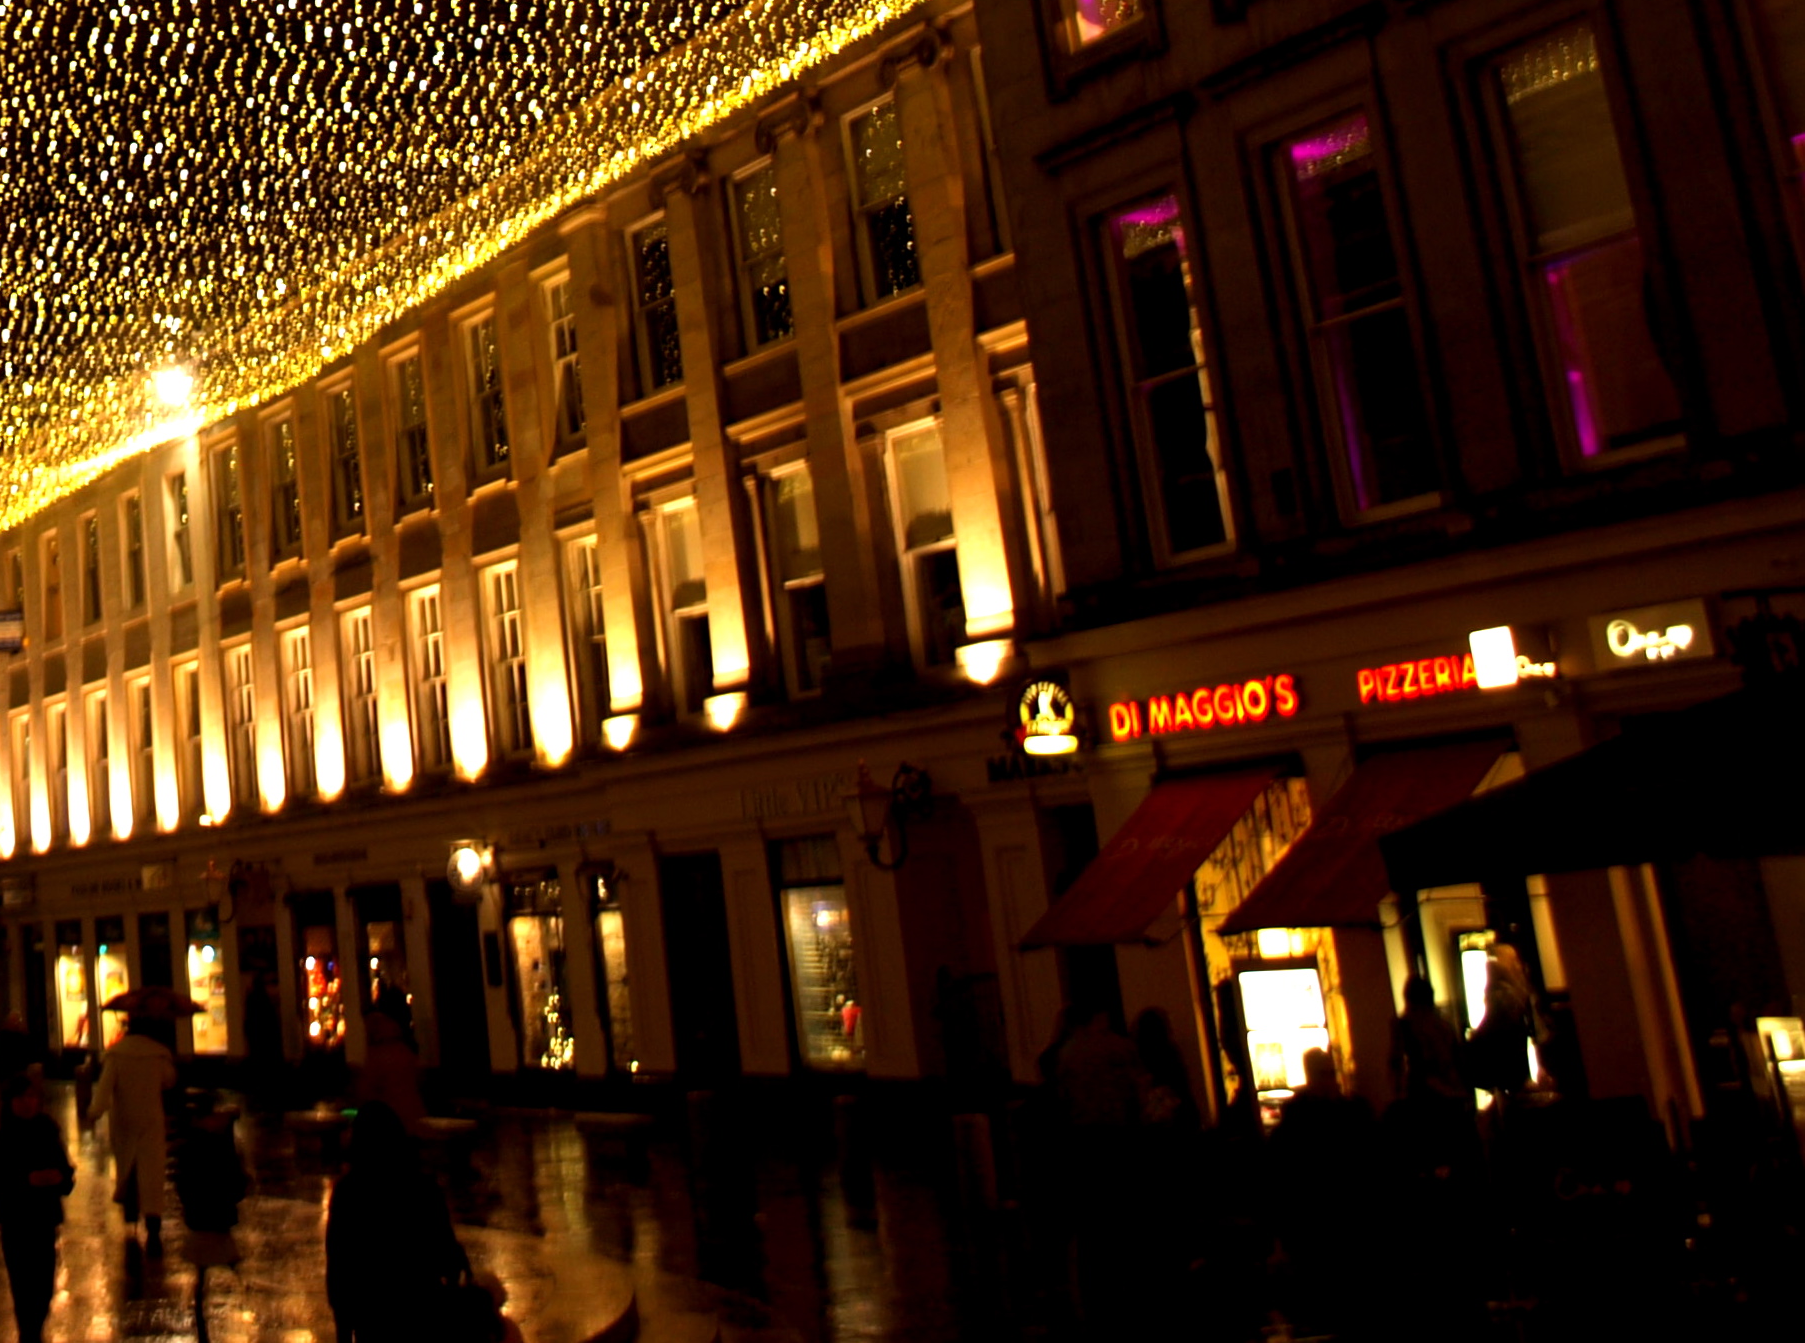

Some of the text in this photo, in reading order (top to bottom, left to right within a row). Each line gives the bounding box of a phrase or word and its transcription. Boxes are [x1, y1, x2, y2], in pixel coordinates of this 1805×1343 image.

[1109, 674, 1299, 742] DI MAGGIO'S
[1358, 653, 1479, 705] PIZZERIA
